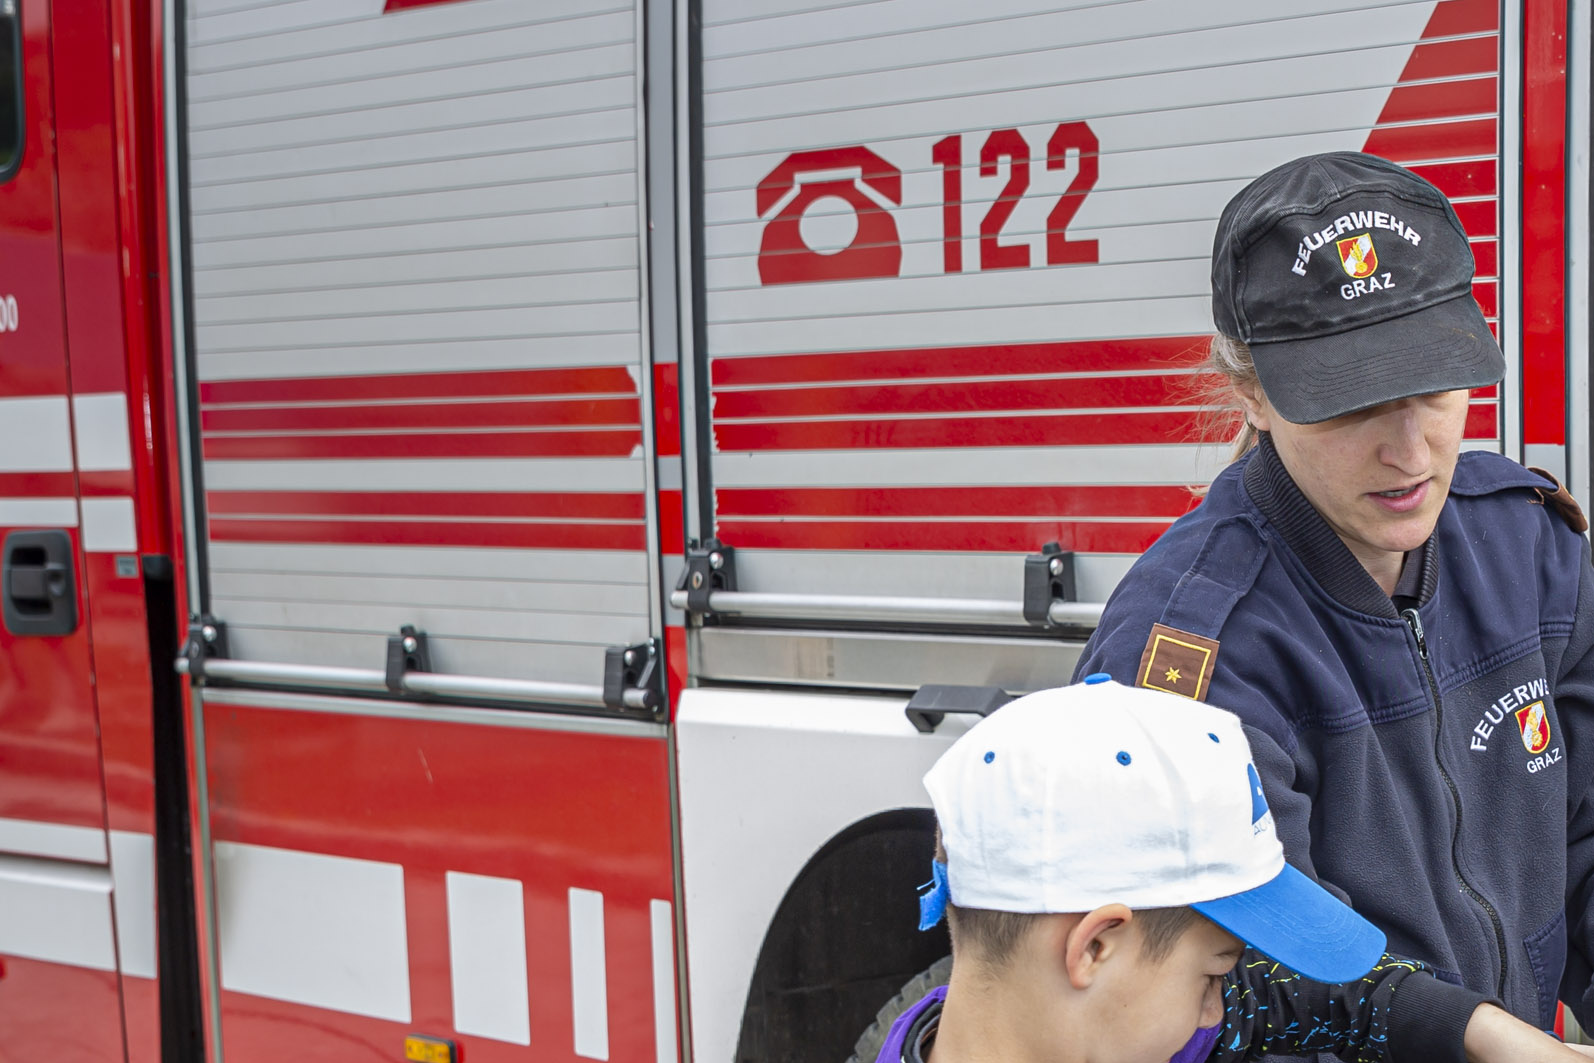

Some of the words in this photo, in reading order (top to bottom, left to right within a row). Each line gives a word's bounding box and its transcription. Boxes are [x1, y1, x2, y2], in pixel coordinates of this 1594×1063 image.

[932, 121, 1099, 273] 122
[1291, 210, 1422, 277] FEUERWEHR
[1340, 272, 1396, 300] GRAZ
[1527, 747, 1562, 773] GRAZ
